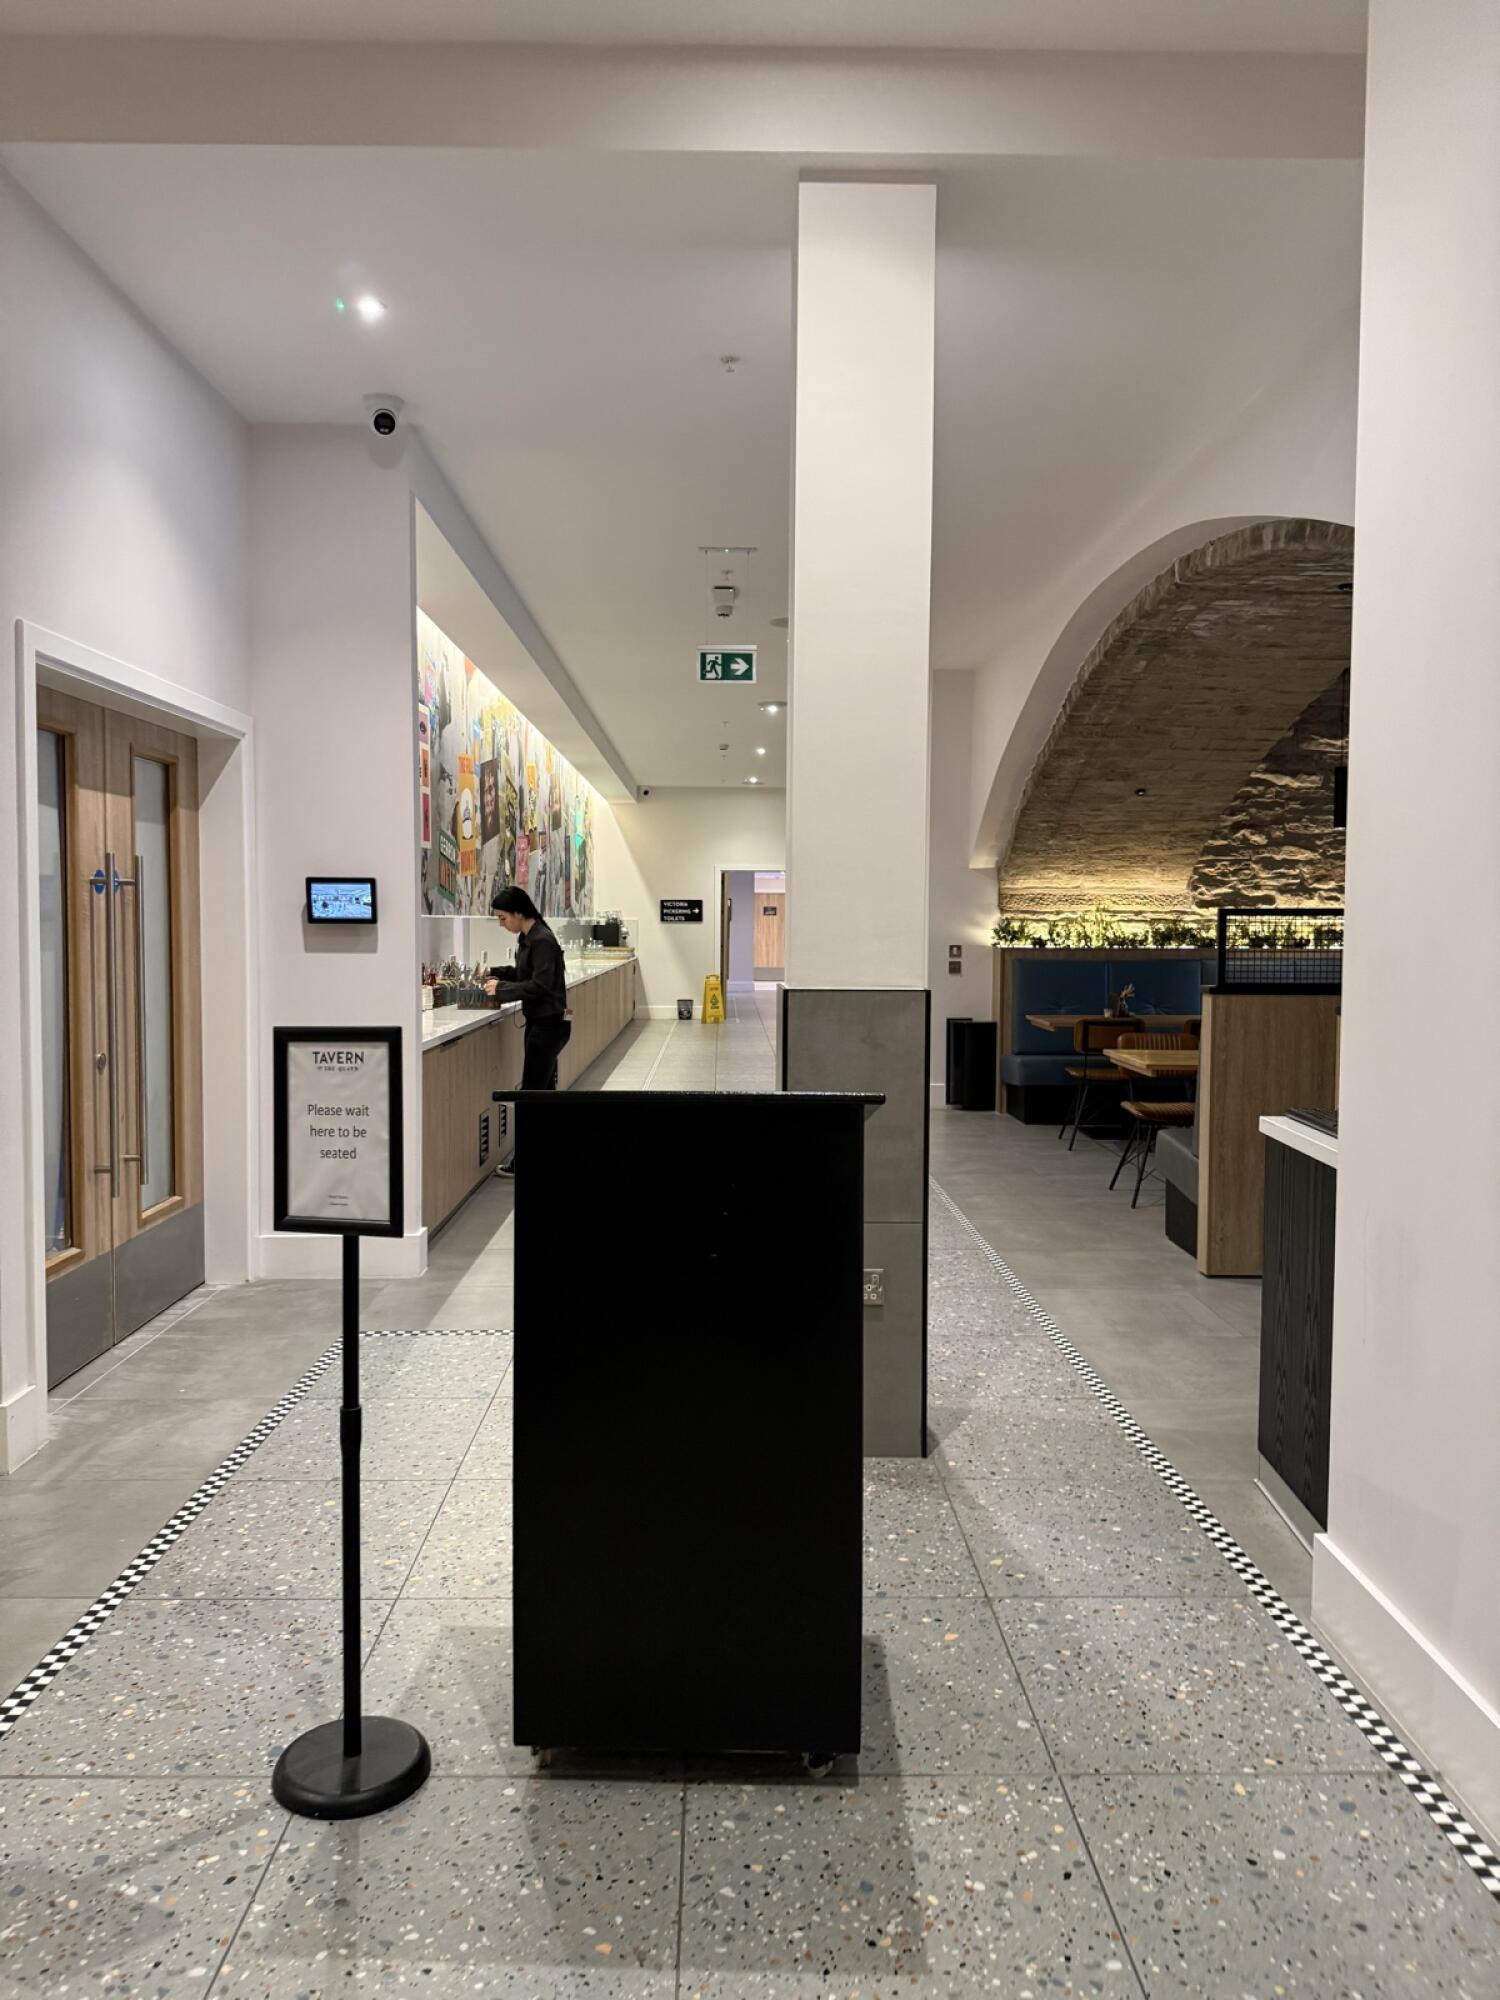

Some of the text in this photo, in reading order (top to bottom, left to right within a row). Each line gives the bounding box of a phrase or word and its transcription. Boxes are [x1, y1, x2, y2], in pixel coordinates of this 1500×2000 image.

[312, 1051, 365, 1064] TAVERN
[307, 1103, 370, 1117] Please wait
[309, 1125, 367, 1138] here to be
[319, 1147, 357, 1160] seated
